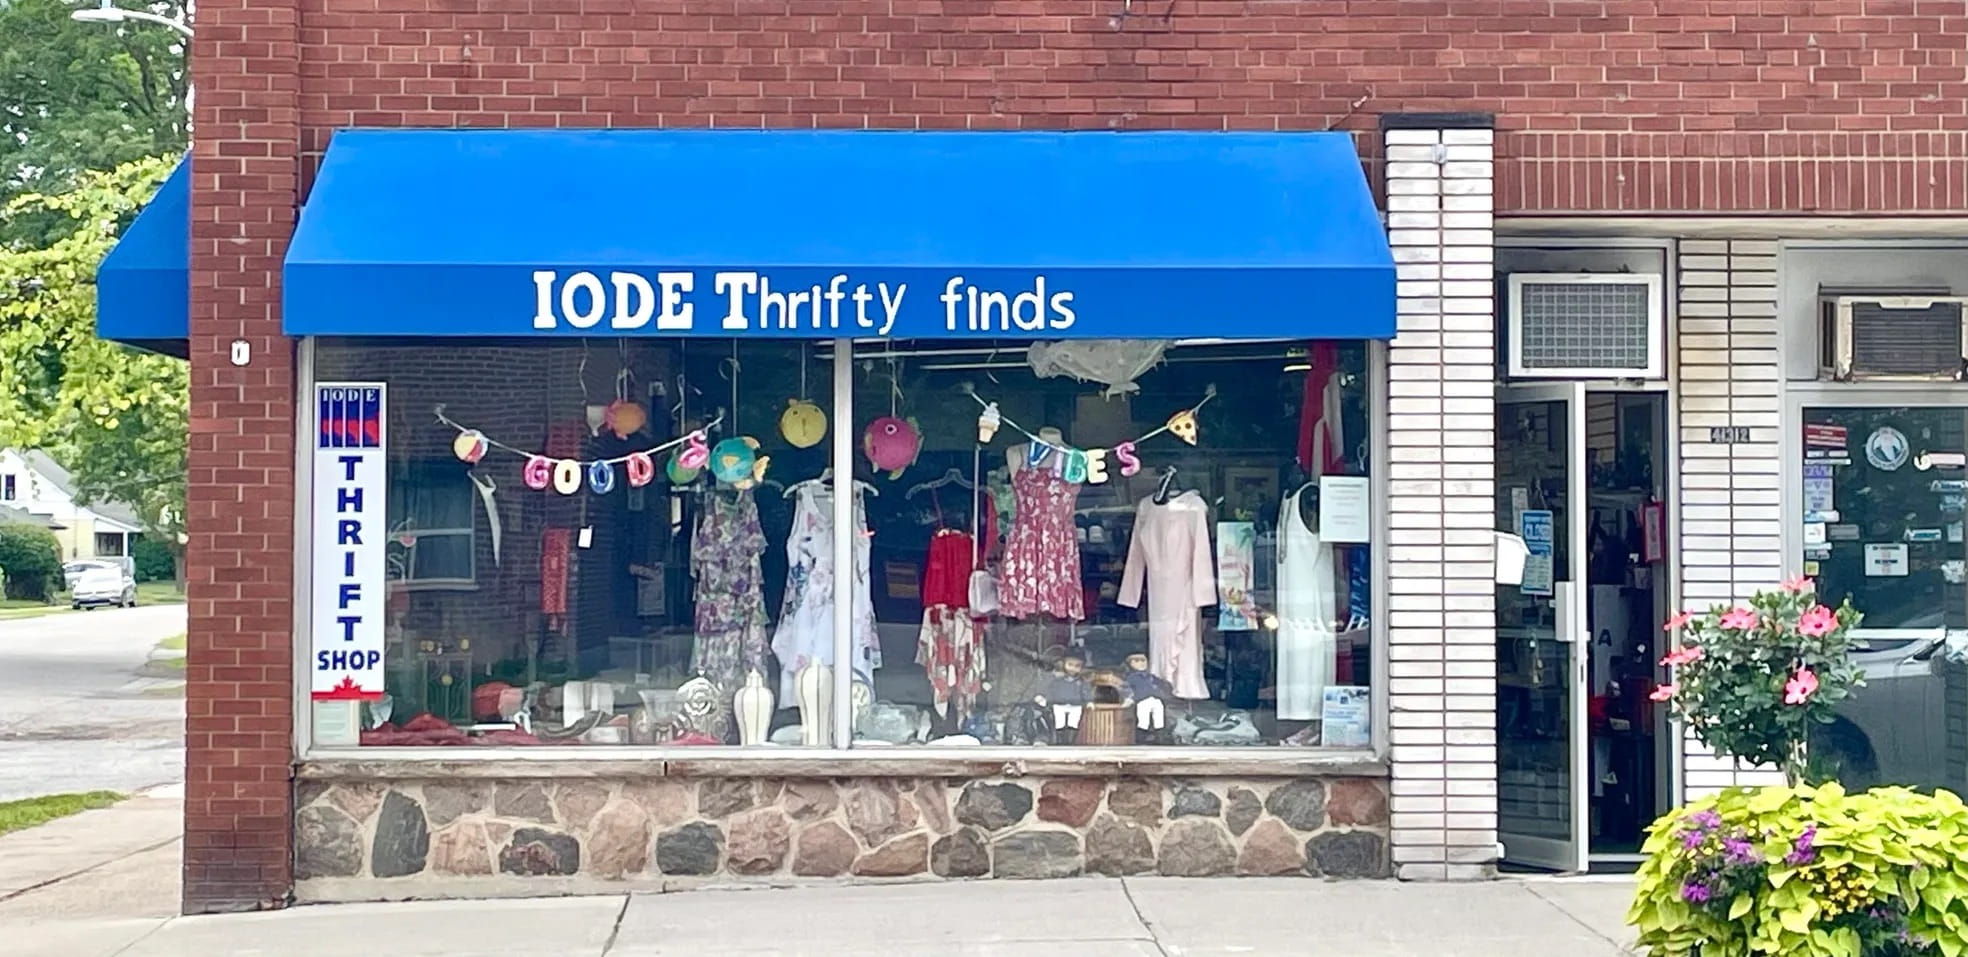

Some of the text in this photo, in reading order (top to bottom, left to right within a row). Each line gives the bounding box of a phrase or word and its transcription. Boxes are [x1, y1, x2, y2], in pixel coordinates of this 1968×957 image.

[533, 271, 1075, 335] IODE Thrifty finds
[323, 389, 376, 402] IODE
[524, 453, 654, 495] GOOD
[1027, 441, 1141, 484] VIBES
[337, 456, 364, 642] THRIFT
[317, 650, 381, 671] SHOP
